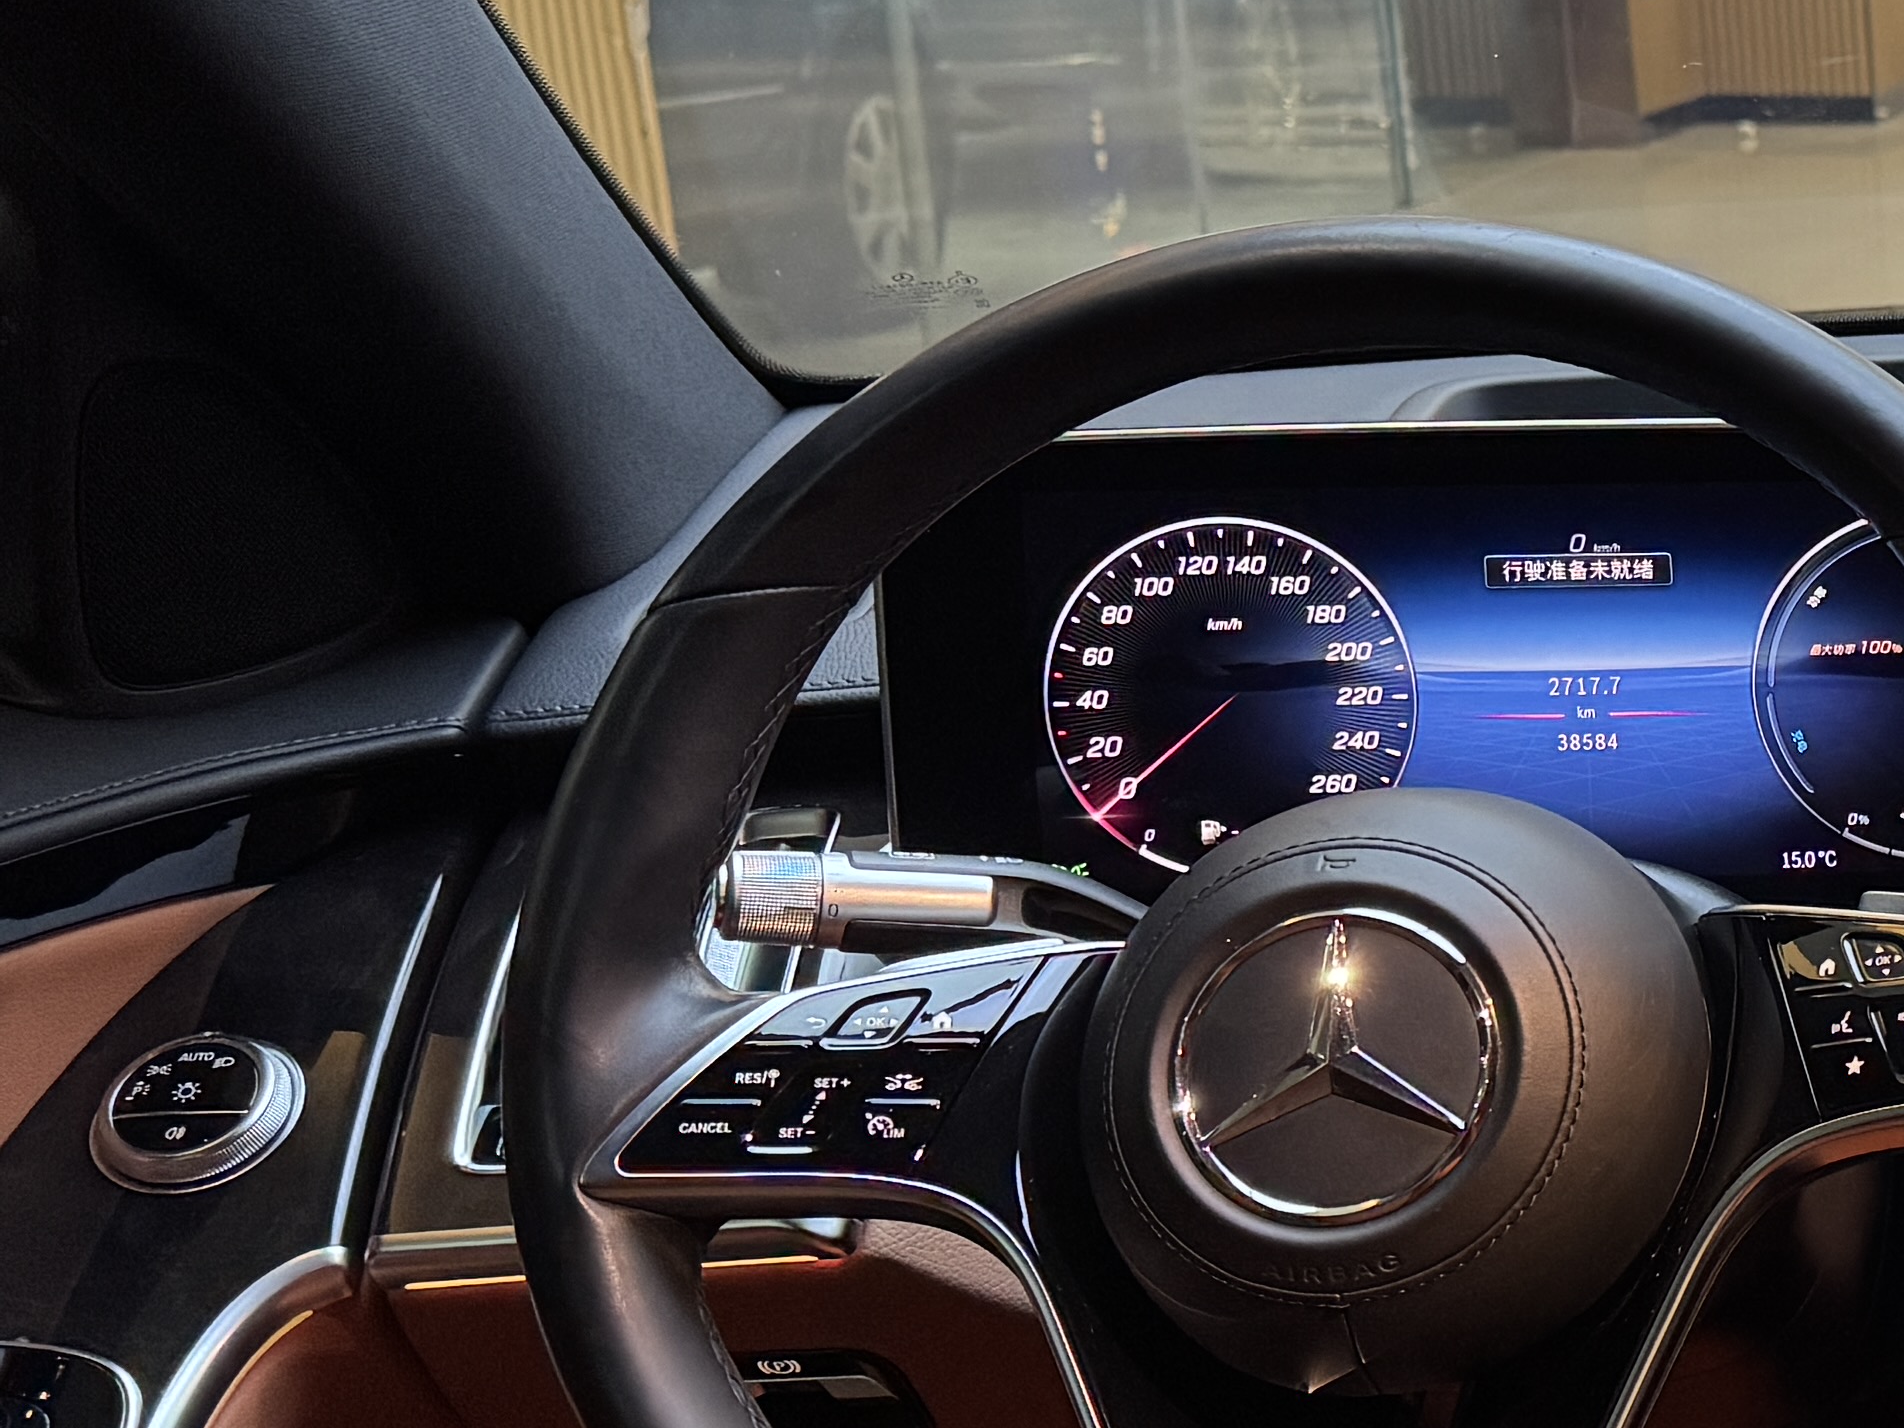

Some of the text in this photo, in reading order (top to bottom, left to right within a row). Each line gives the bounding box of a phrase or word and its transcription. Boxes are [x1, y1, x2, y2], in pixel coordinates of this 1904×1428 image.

[1569, 533, 1587, 553] 0
[1178, 555, 1218, 576] 120
[1226, 555, 1266, 576] 140
[1503, 559, 1654, 583] 行驶准备未就绪
[1134, 576, 1174, 597] 100
[1270, 575, 1310, 596] 160
[1101, 605, 1133, 624] 80
[1306, 604, 1346, 624] 180
[1207, 618, 1243, 632] km/h
[1083, 647, 1113, 666] 60
[1325, 642, 1372, 662] 200
[1861, 640, 1903, 655] 100%
[1336, 686, 1383, 706] 220
[1548, 676, 1621, 696] 2717.7
[1076, 690, 1108, 710] 40
[1577, 706, 1596, 719] km
[1087, 737, 1122, 757] 20
[1333, 731, 1380, 750] 240
[1557, 733, 1619, 751] 38584
[1118, 777, 1138, 799] 0
[1309, 774, 1356, 794] 260
[1848, 812, 1870, 826] 0%
[1144, 828, 1155, 842] 0
[1875, 954, 1891, 966] OK
[866, 1017, 885, 1026] OK
[178, 1051, 215, 1062] AUTO
[679, 1122, 732, 1133] CANCEL
[883, 1128, 905, 1138] LIM
[1262, 1254, 1399, 1284] AIRBAG
